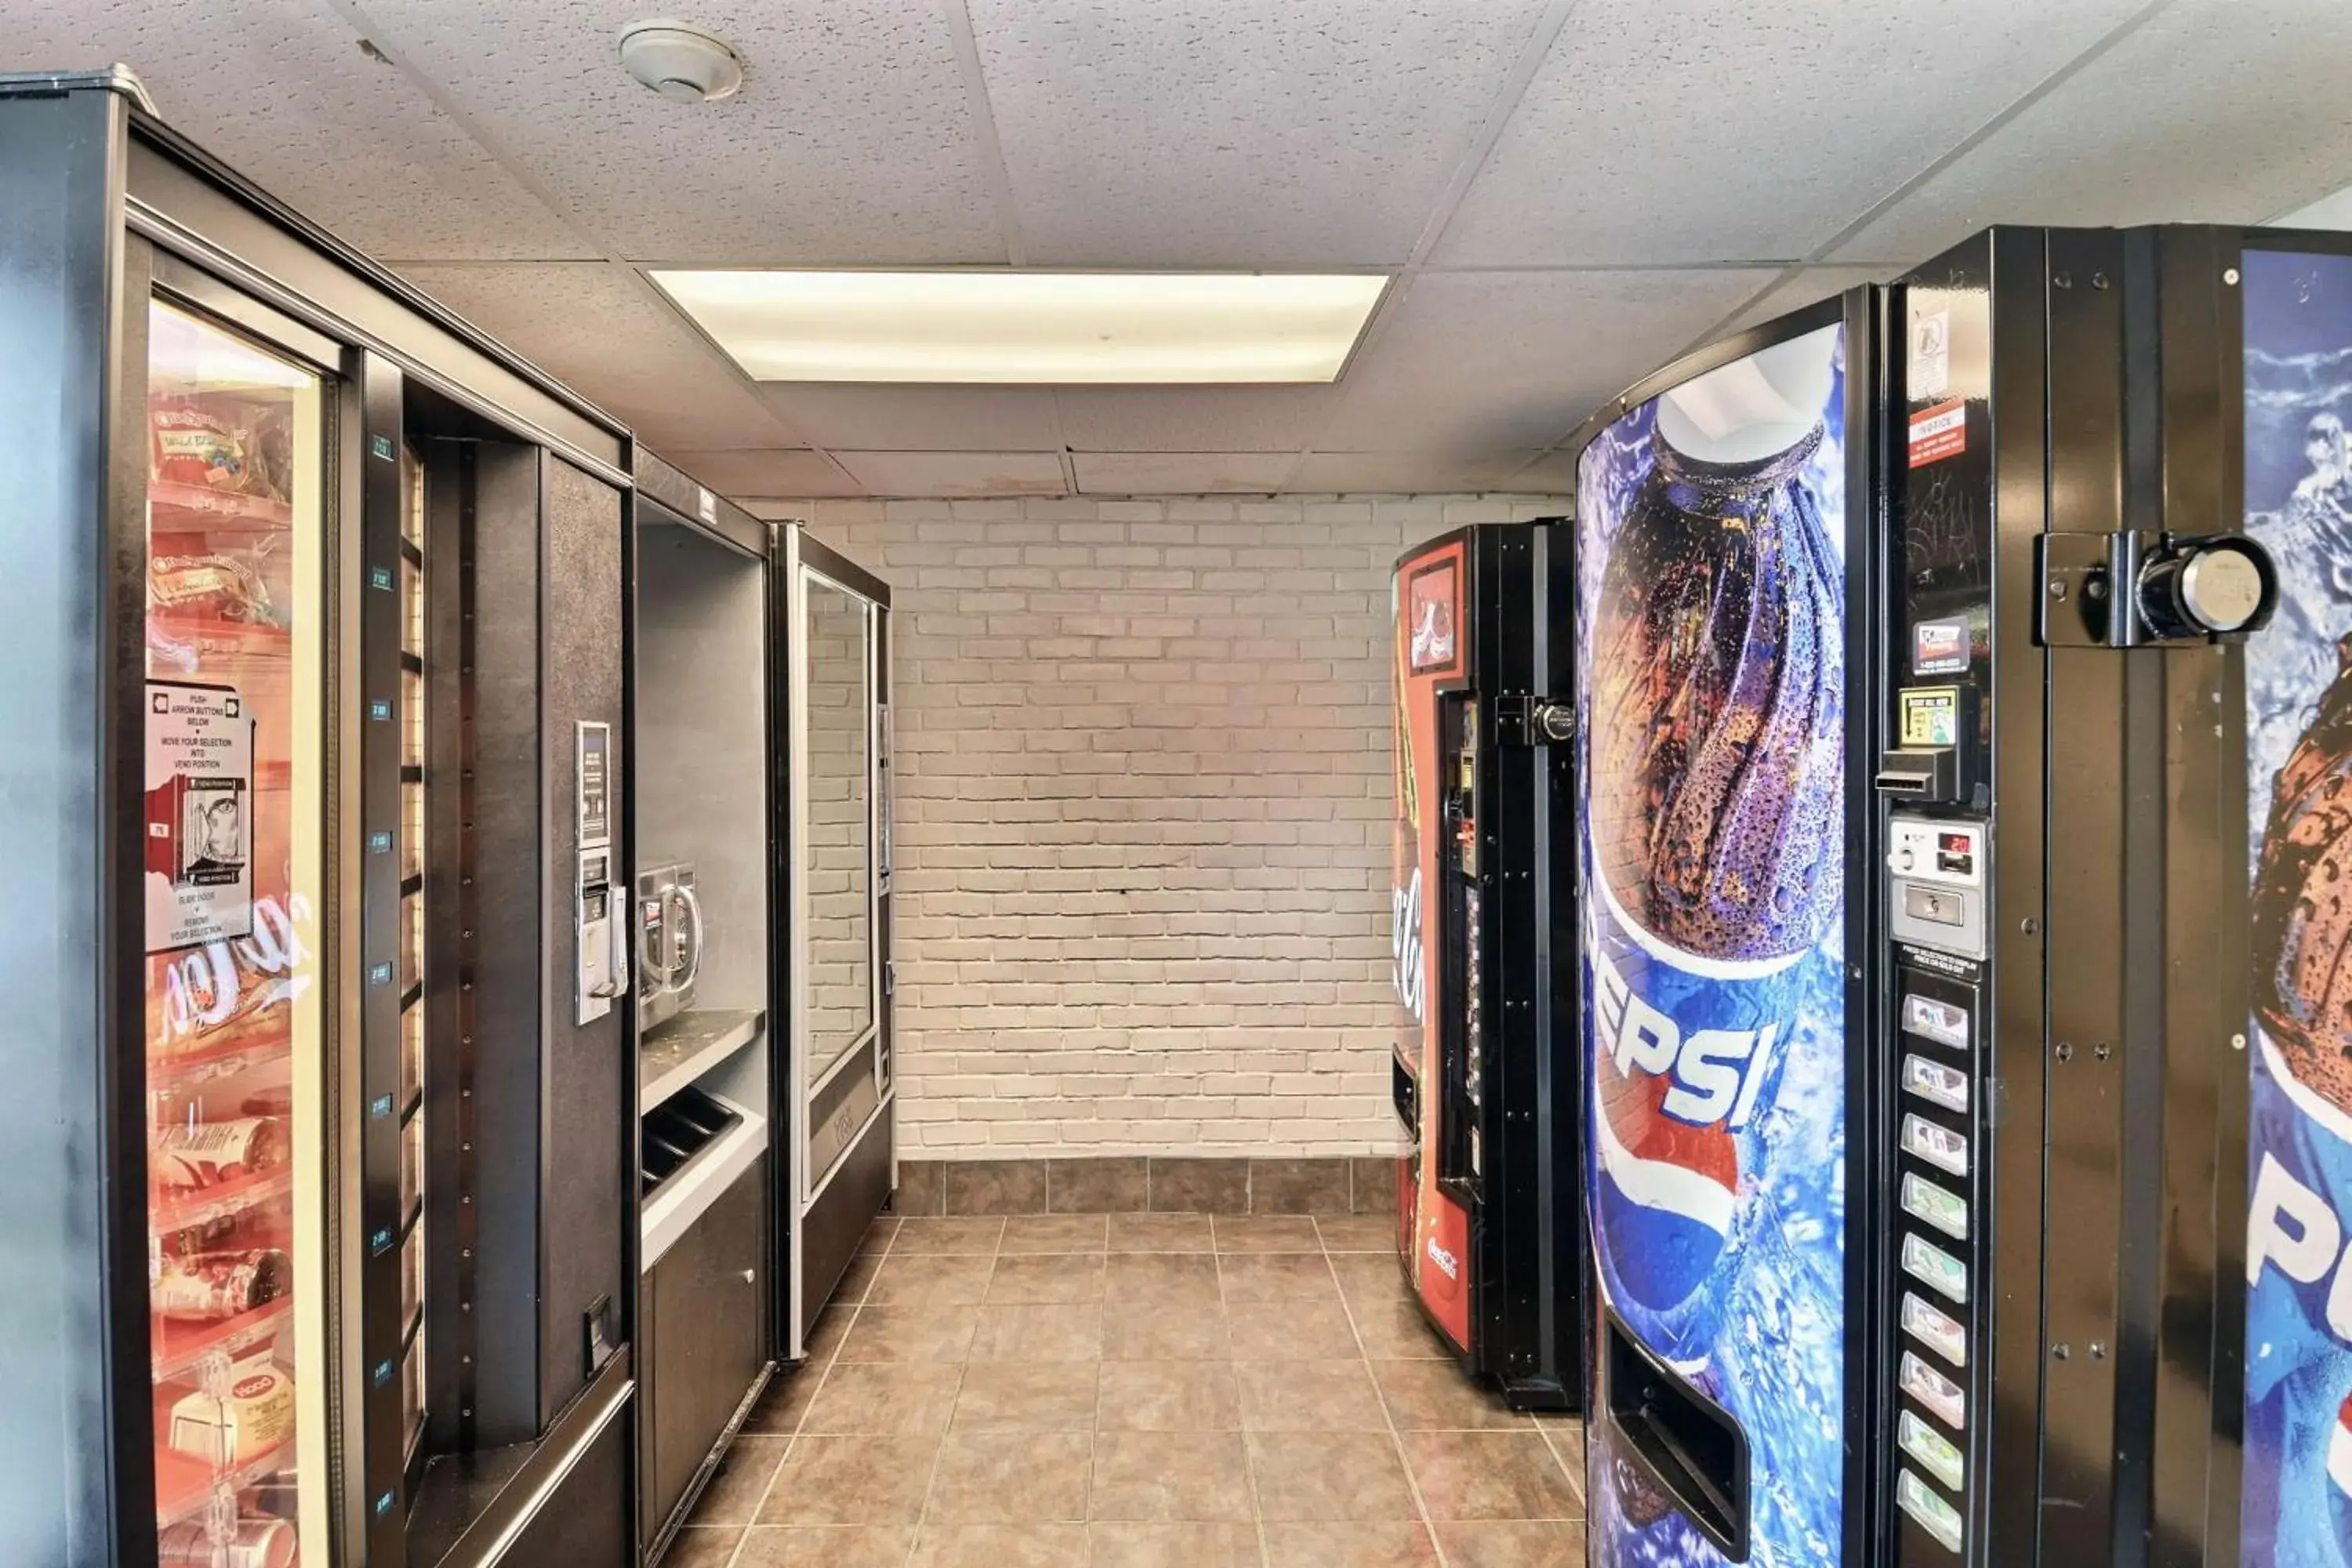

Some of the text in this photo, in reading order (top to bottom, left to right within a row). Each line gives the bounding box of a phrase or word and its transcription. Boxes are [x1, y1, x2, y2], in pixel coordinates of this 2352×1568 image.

[190, 695, 207, 704] PUSH
[172, 705, 223, 716] ARROW BUTTONS
[187, 717, 209, 726] BELOW
[200, 738, 232, 747] SELECTION
[191, 749, 205, 757] INTO
[175, 760, 220, 769] VEND POSITION
[171, 927, 223, 941] YOUR SELECTION
